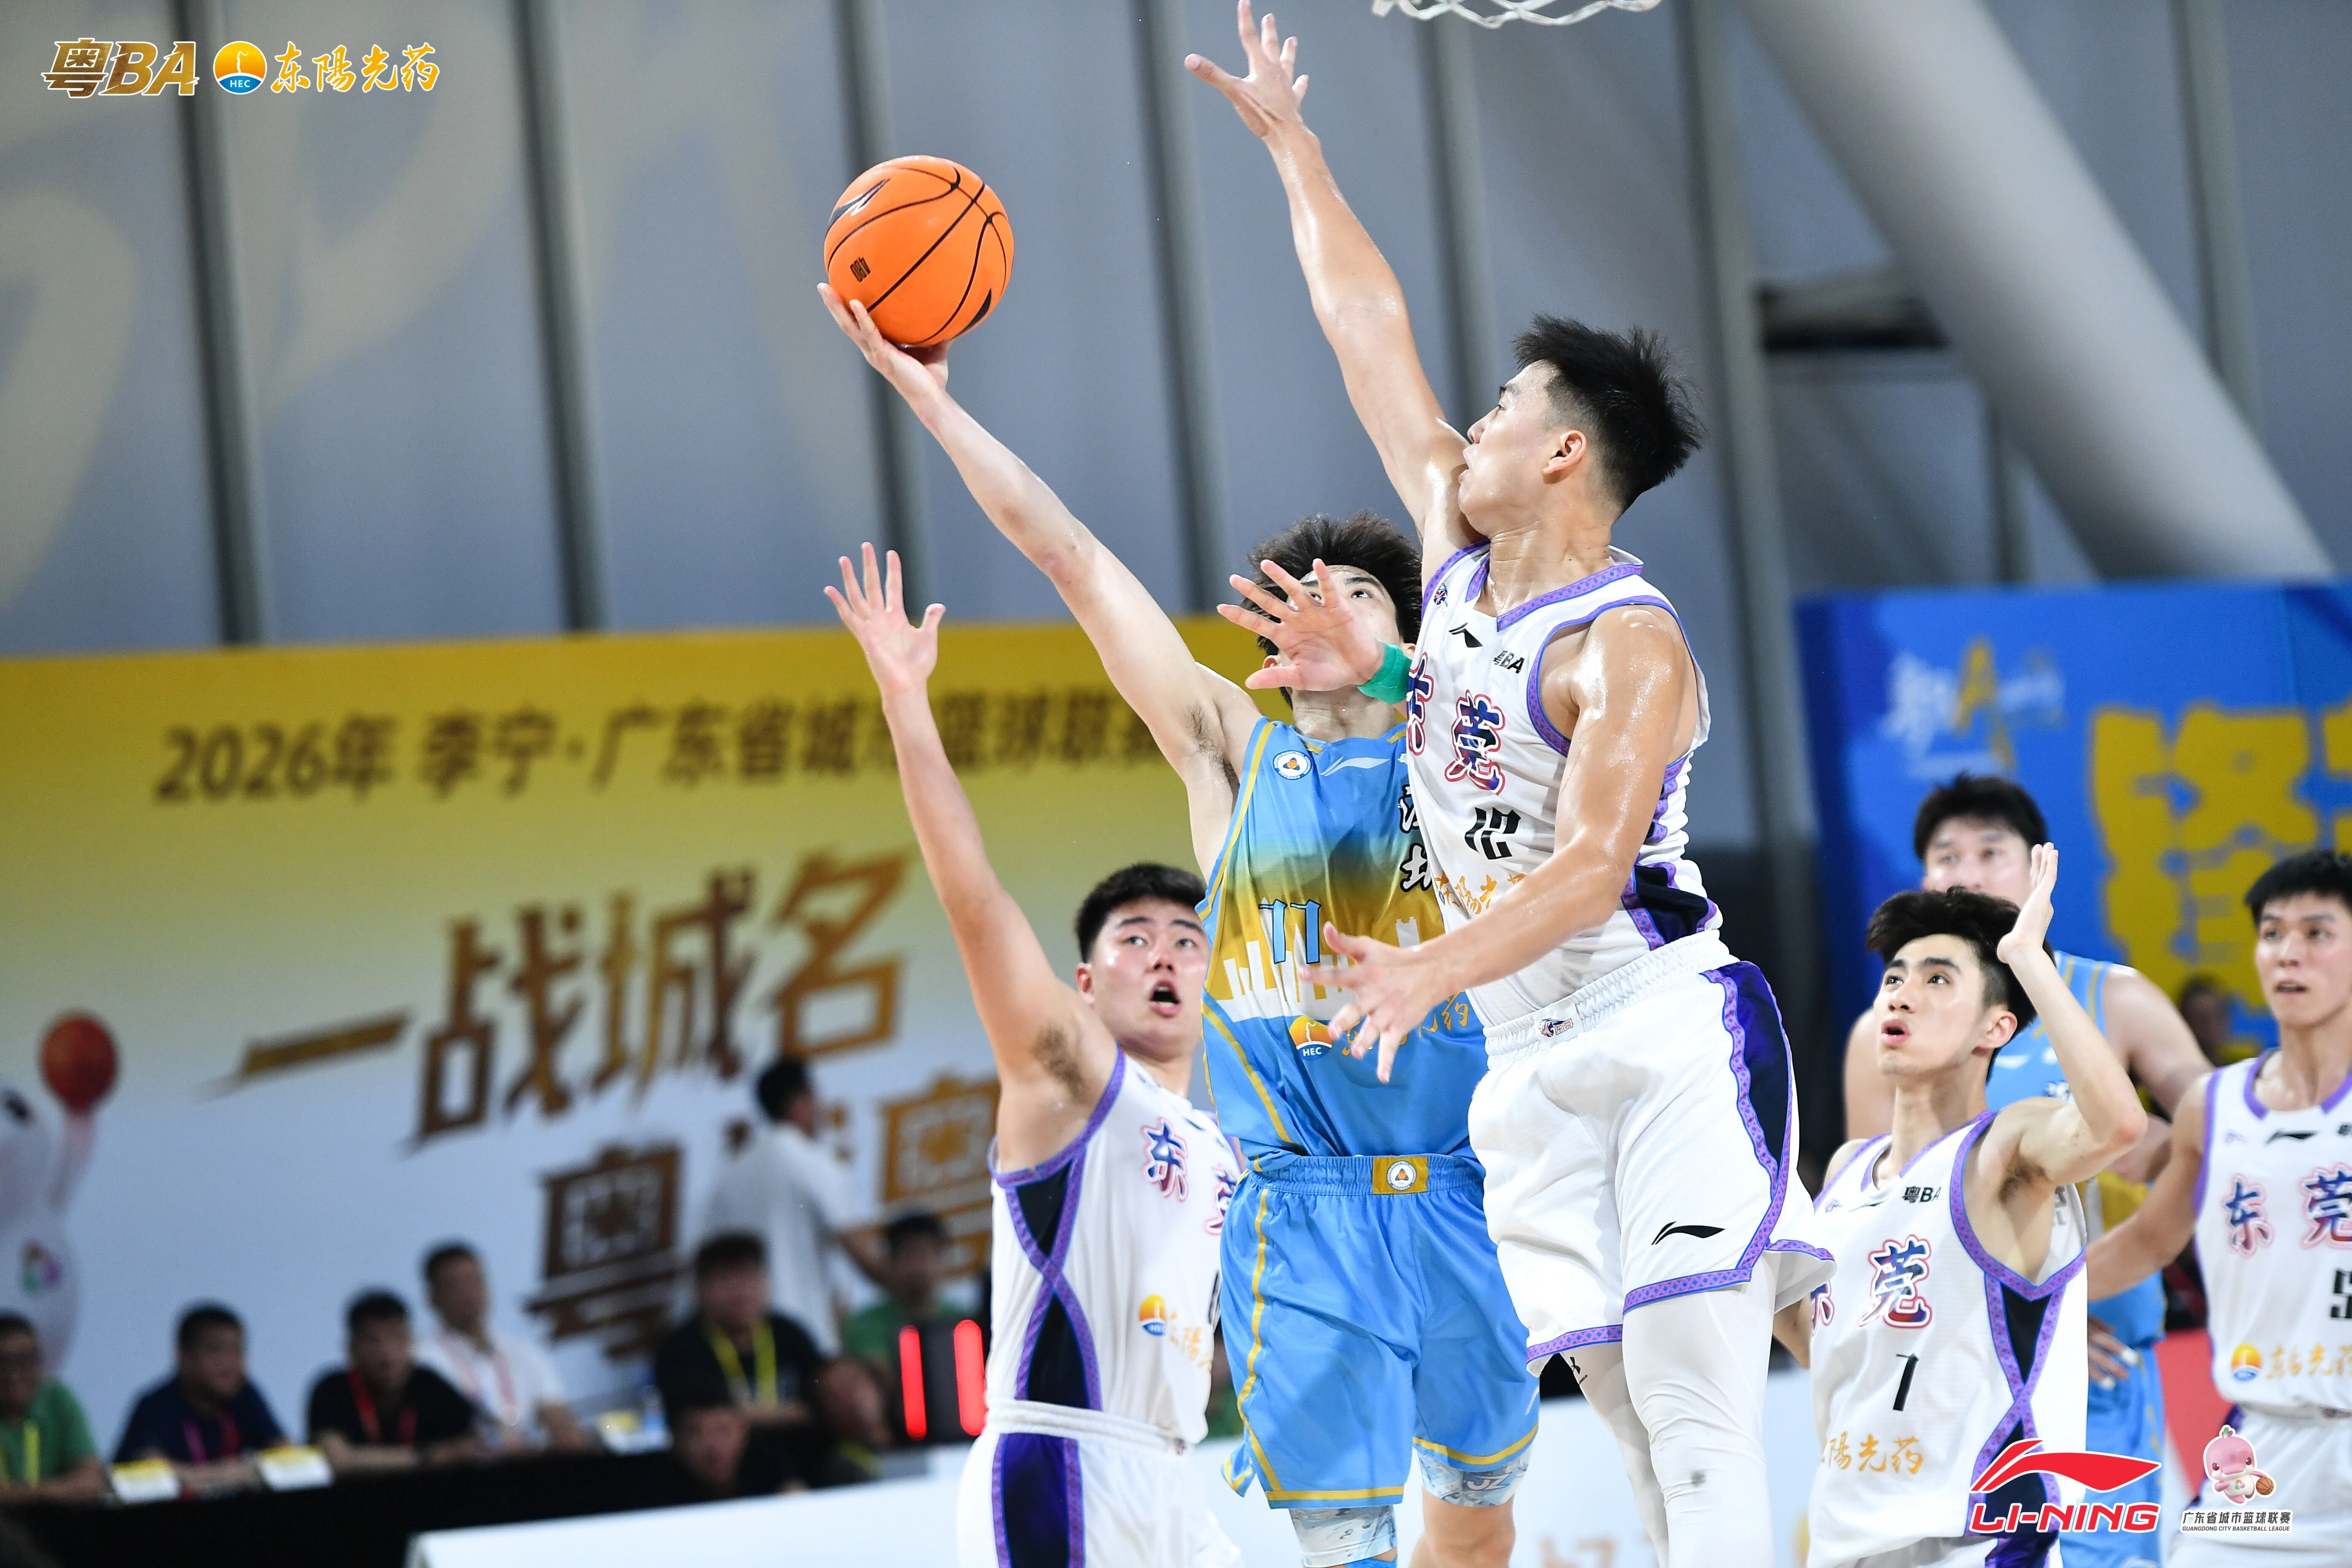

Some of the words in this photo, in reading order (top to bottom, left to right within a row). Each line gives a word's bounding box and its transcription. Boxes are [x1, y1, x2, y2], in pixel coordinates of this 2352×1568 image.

[154, 710, 398, 805] 2026年
[1465, 807, 1521, 860] 12
[1259, 899, 1321, 964] 11
[1303, 1047, 1322, 1057] HEC
